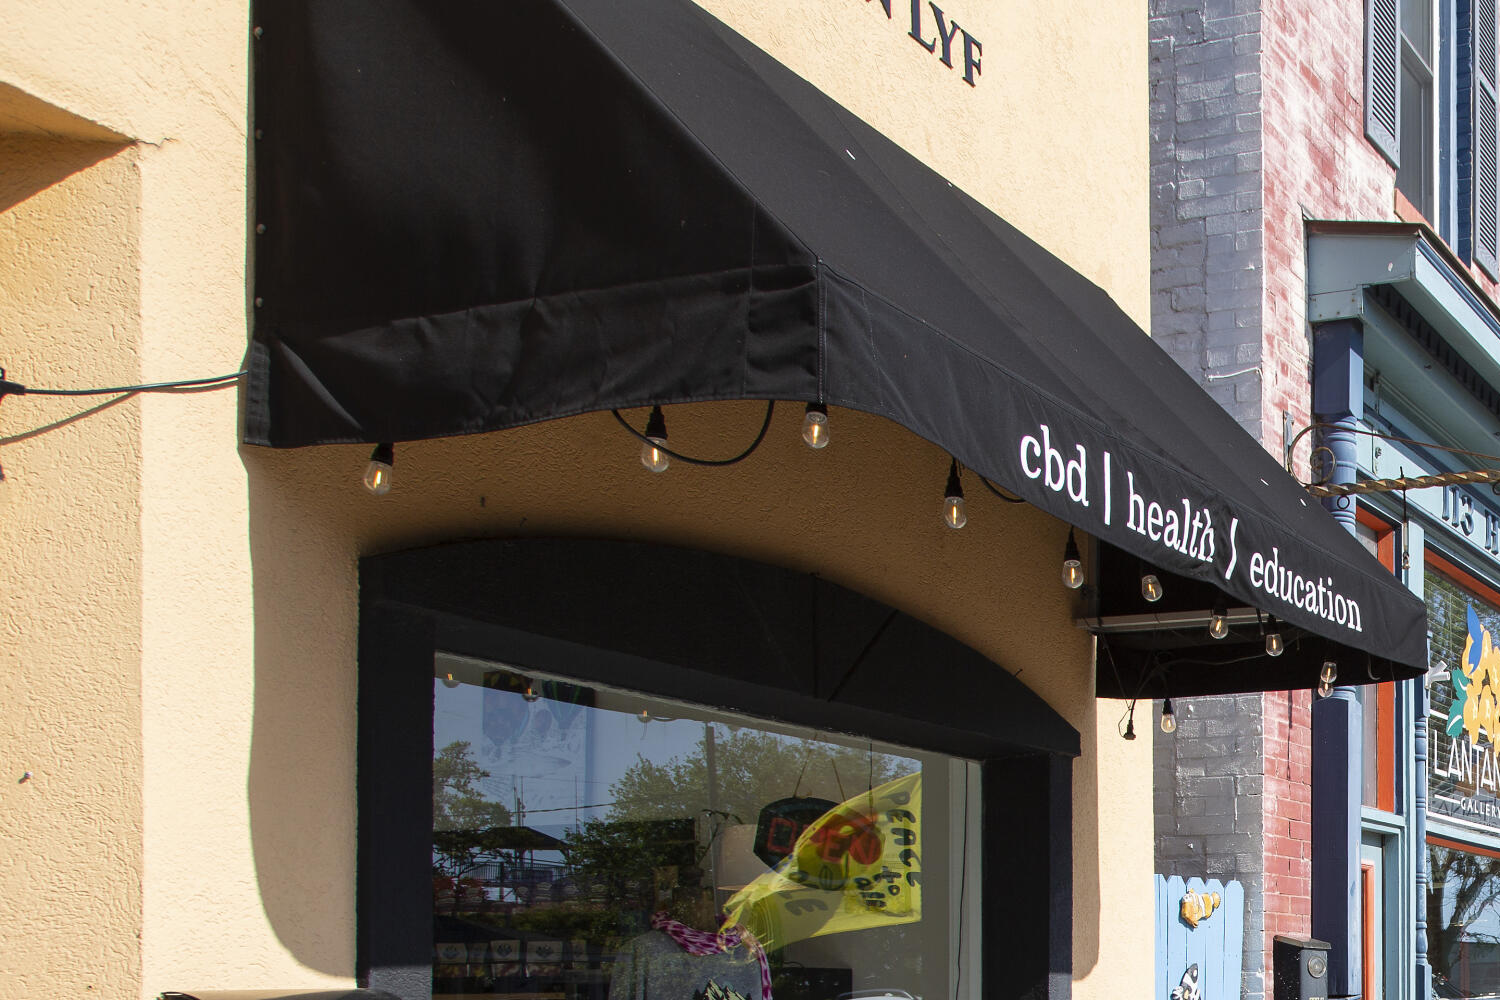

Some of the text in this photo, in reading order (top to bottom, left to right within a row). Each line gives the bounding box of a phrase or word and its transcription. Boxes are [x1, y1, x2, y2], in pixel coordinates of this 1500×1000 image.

[906, 0, 982, 88] LYF
[1020, 424, 1089, 508] cbd
[1126, 471, 1215, 563] health
[1249, 547, 1363, 632] education
